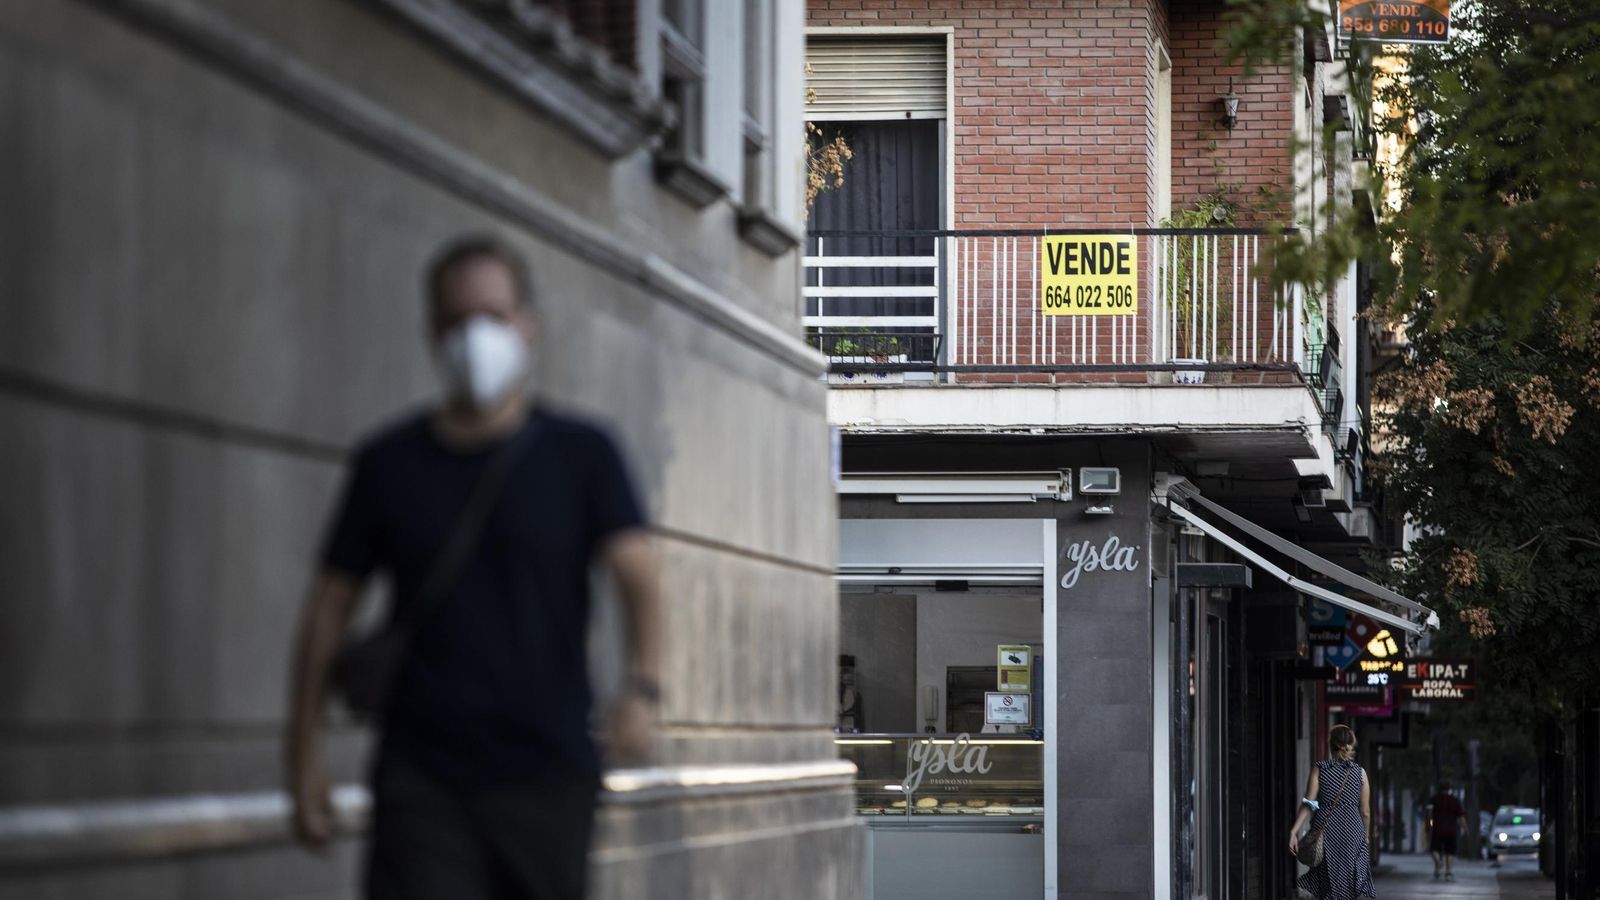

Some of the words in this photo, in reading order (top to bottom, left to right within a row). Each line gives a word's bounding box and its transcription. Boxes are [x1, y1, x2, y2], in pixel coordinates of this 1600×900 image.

[1369, 4, 1421, 17] VENDE
[1416, 21, 1445, 35] 110
[1046, 242, 1131, 275] VENDE
[1046, 285, 1071, 308] 664
[1076, 285, 1102, 308] 022
[1107, 285, 1132, 308] 506
[1422, 680, 1453, 689] ROPA
[1411, 688, 1464, 698] LABORAL
[901, 733, 993, 794] ysla
